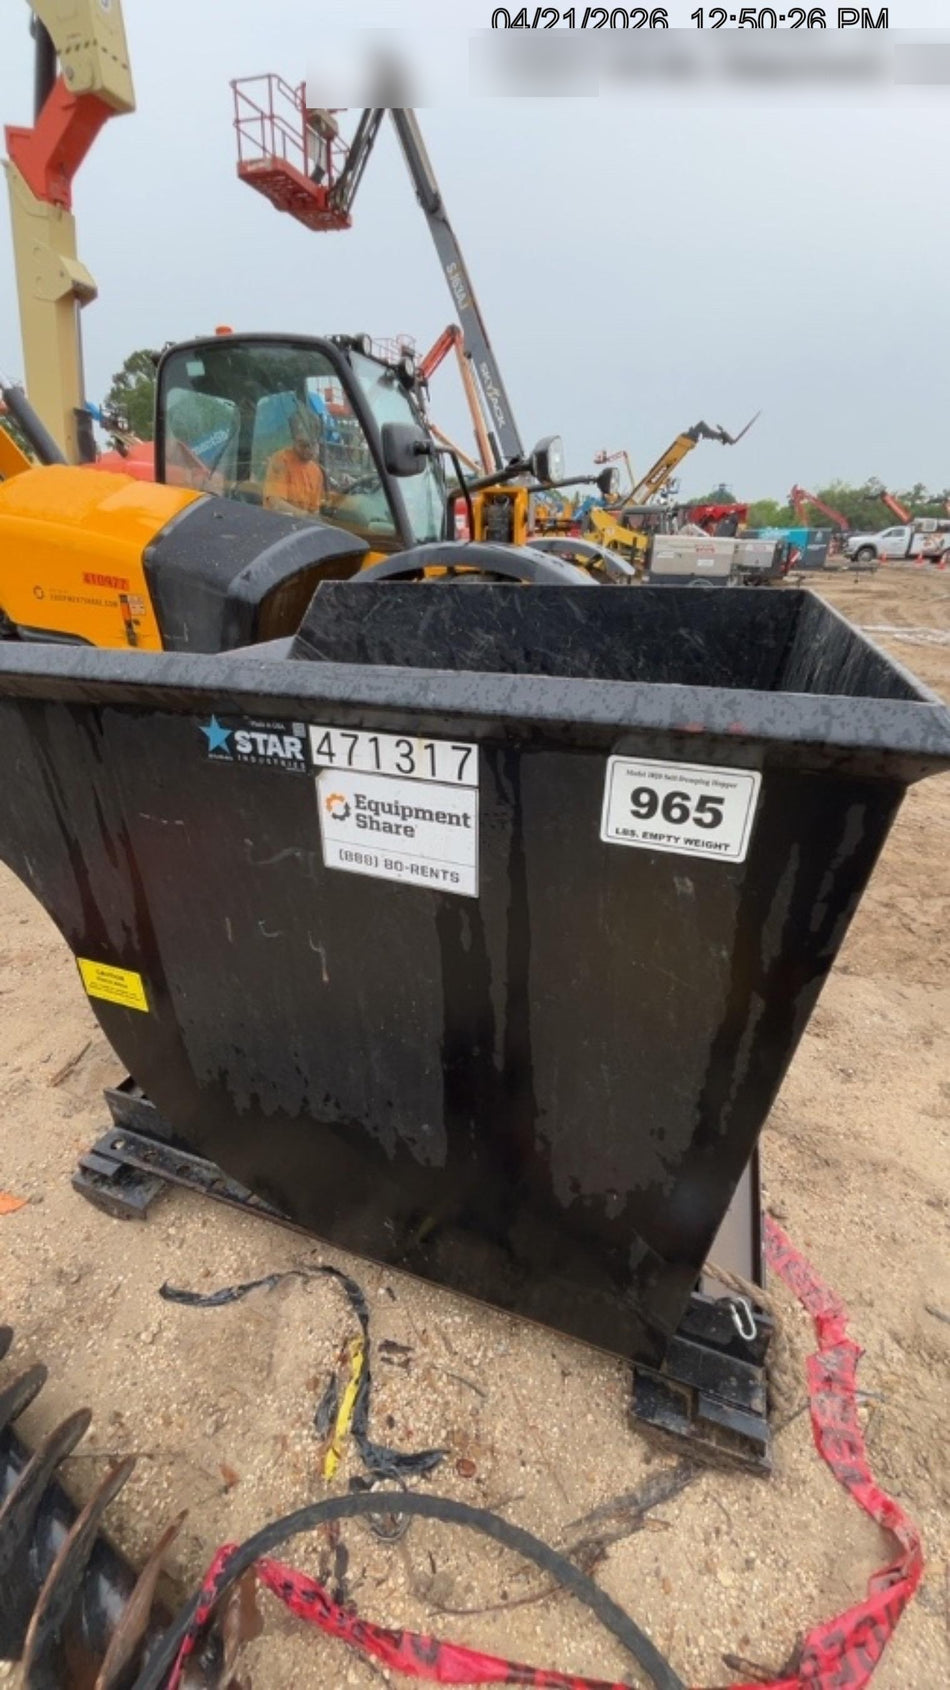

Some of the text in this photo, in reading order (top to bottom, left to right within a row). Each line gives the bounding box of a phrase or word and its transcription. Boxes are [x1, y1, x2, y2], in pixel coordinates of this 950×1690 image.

[480, 361, 506, 428] SKYJACK
[234, 730, 305, 760] STAR
[316, 731, 472, 781] 471317
[354, 793, 472, 829] Equipment
[630, 786, 725, 830] 965
[355, 813, 416, 838] Share
[615, 827, 731, 852] LBS. EMPTY WEIGHT
[384, 858, 461, 884] 80-RENTS
